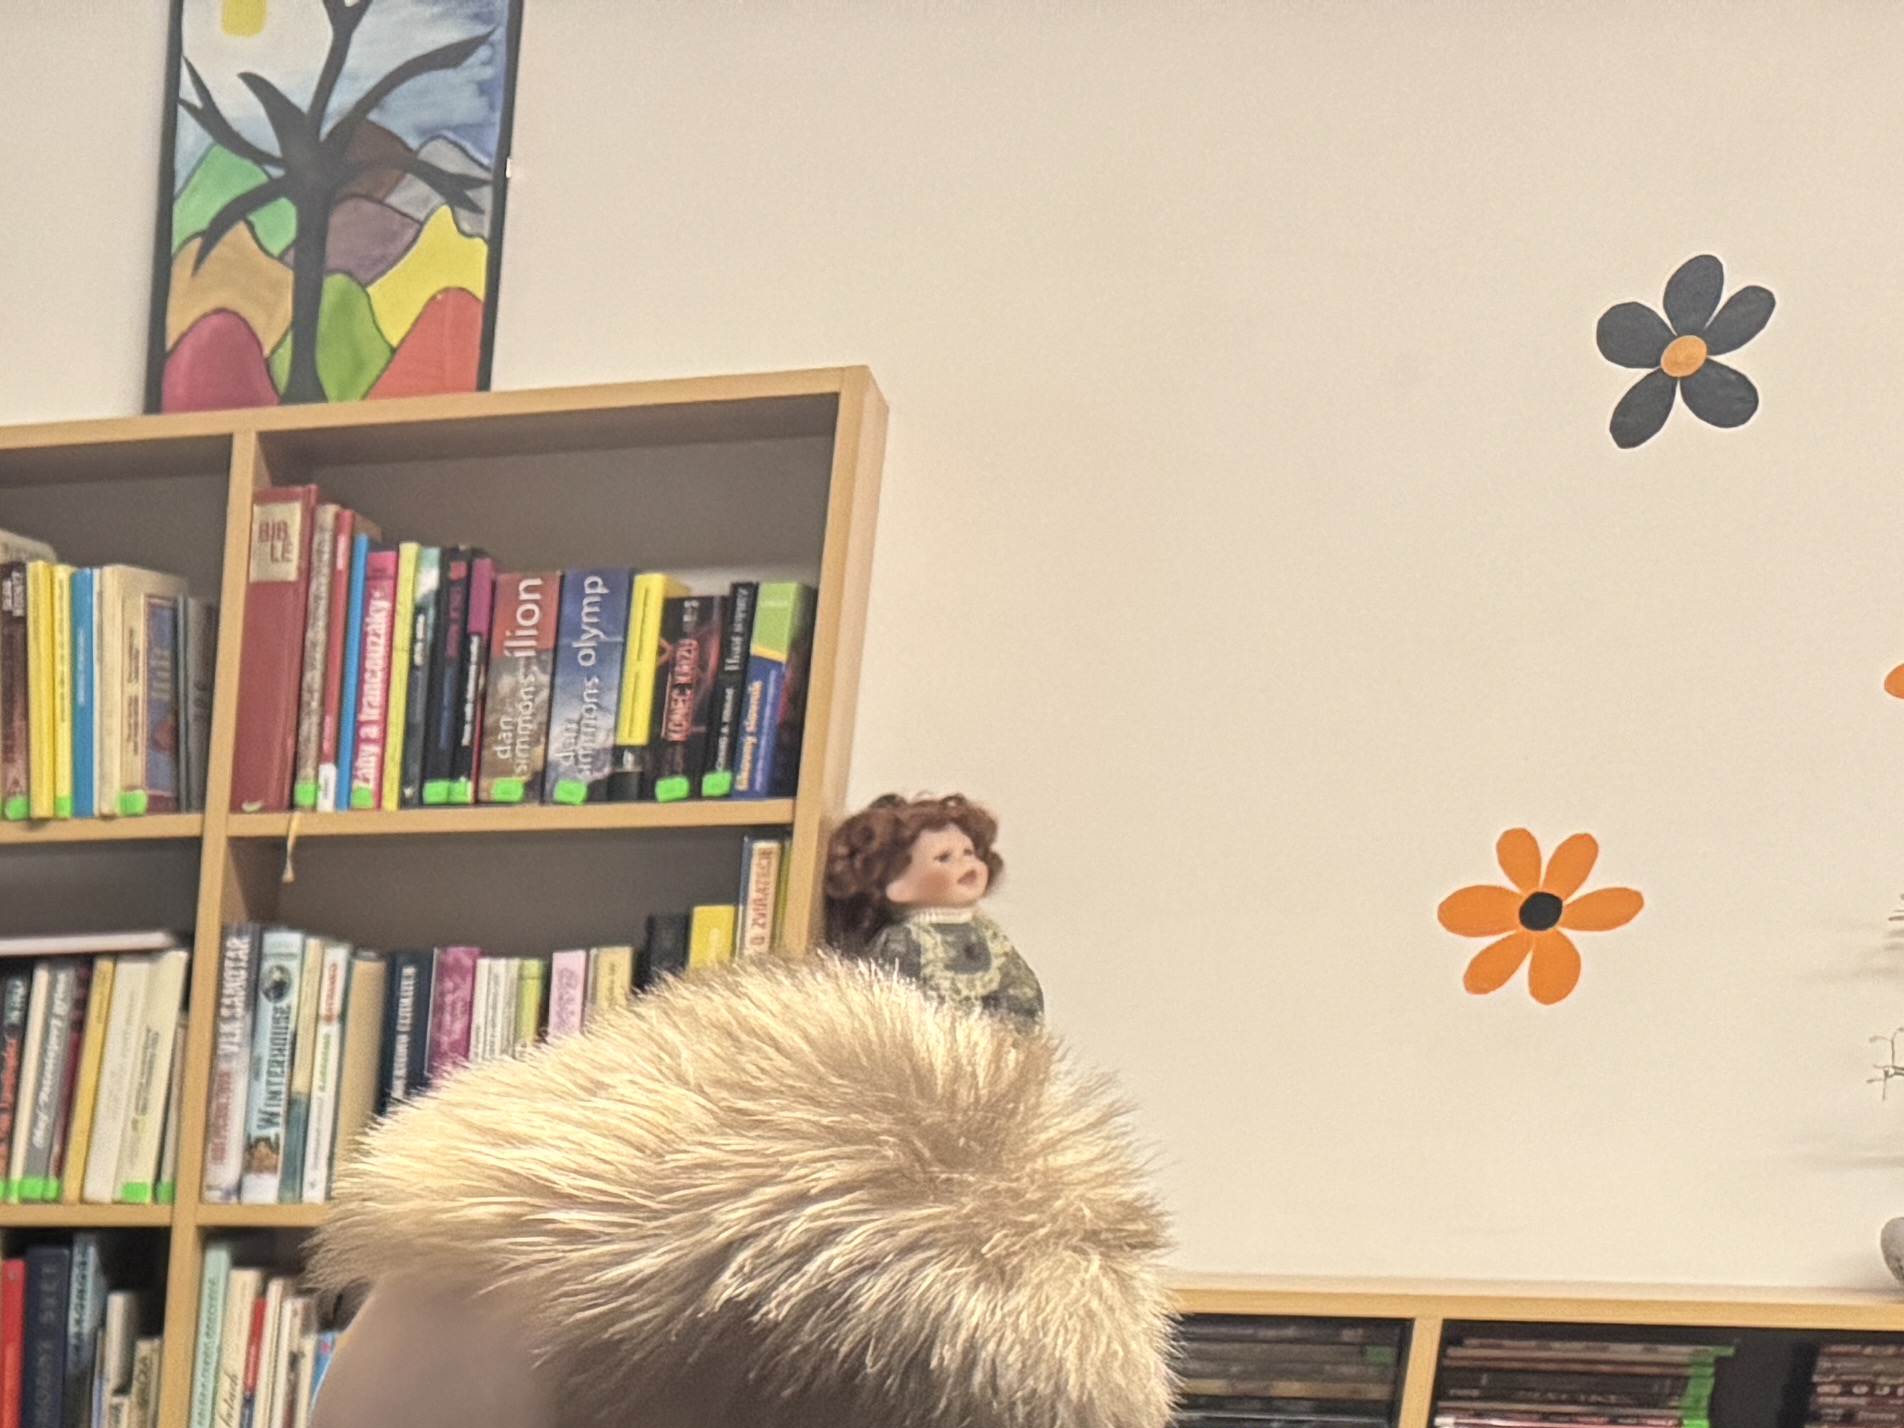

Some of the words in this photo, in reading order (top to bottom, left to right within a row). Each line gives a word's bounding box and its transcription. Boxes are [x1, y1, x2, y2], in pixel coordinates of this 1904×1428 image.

[574, 577, 608, 666] olymp
[494, 717, 513, 759] dan
[511, 675, 535, 773] simmons
[555, 720, 575, 766] dan
[576, 676, 599, 776] simmons
[257, 1003, 291, 1131] WINTERHOUSE
